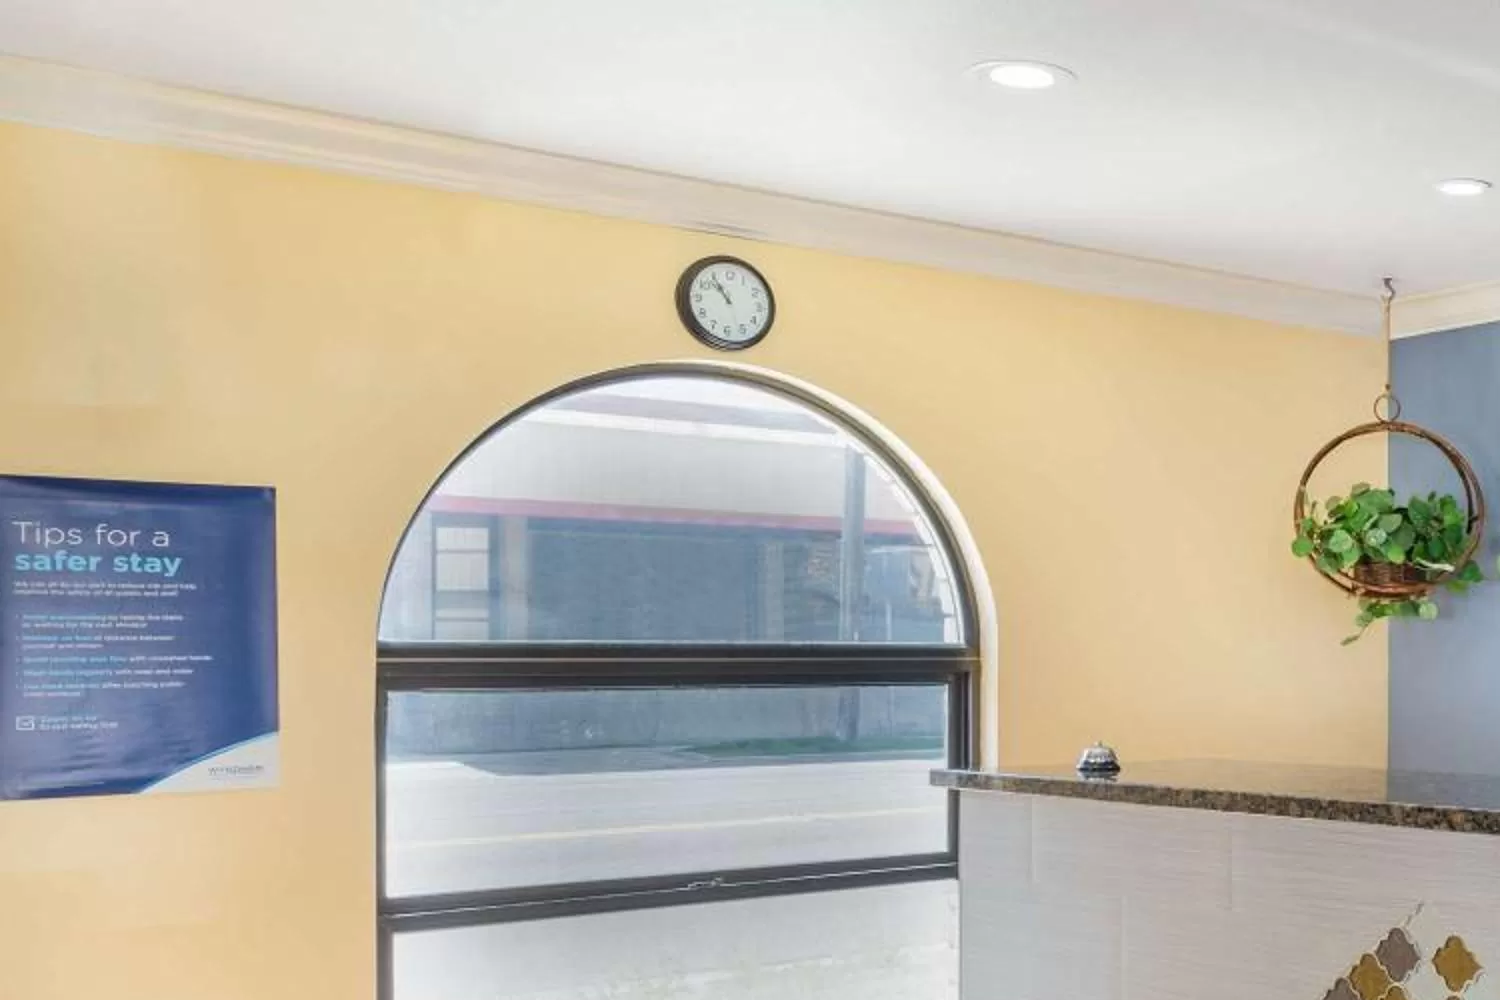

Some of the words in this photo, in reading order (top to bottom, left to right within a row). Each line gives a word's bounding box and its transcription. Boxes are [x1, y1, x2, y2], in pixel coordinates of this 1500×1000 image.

[11, 520, 83, 549] Tips
[95, 522, 141, 547] for
[152, 529, 170, 547] a
[14, 550, 103, 573] safer
[112, 551, 183, 578] stay
